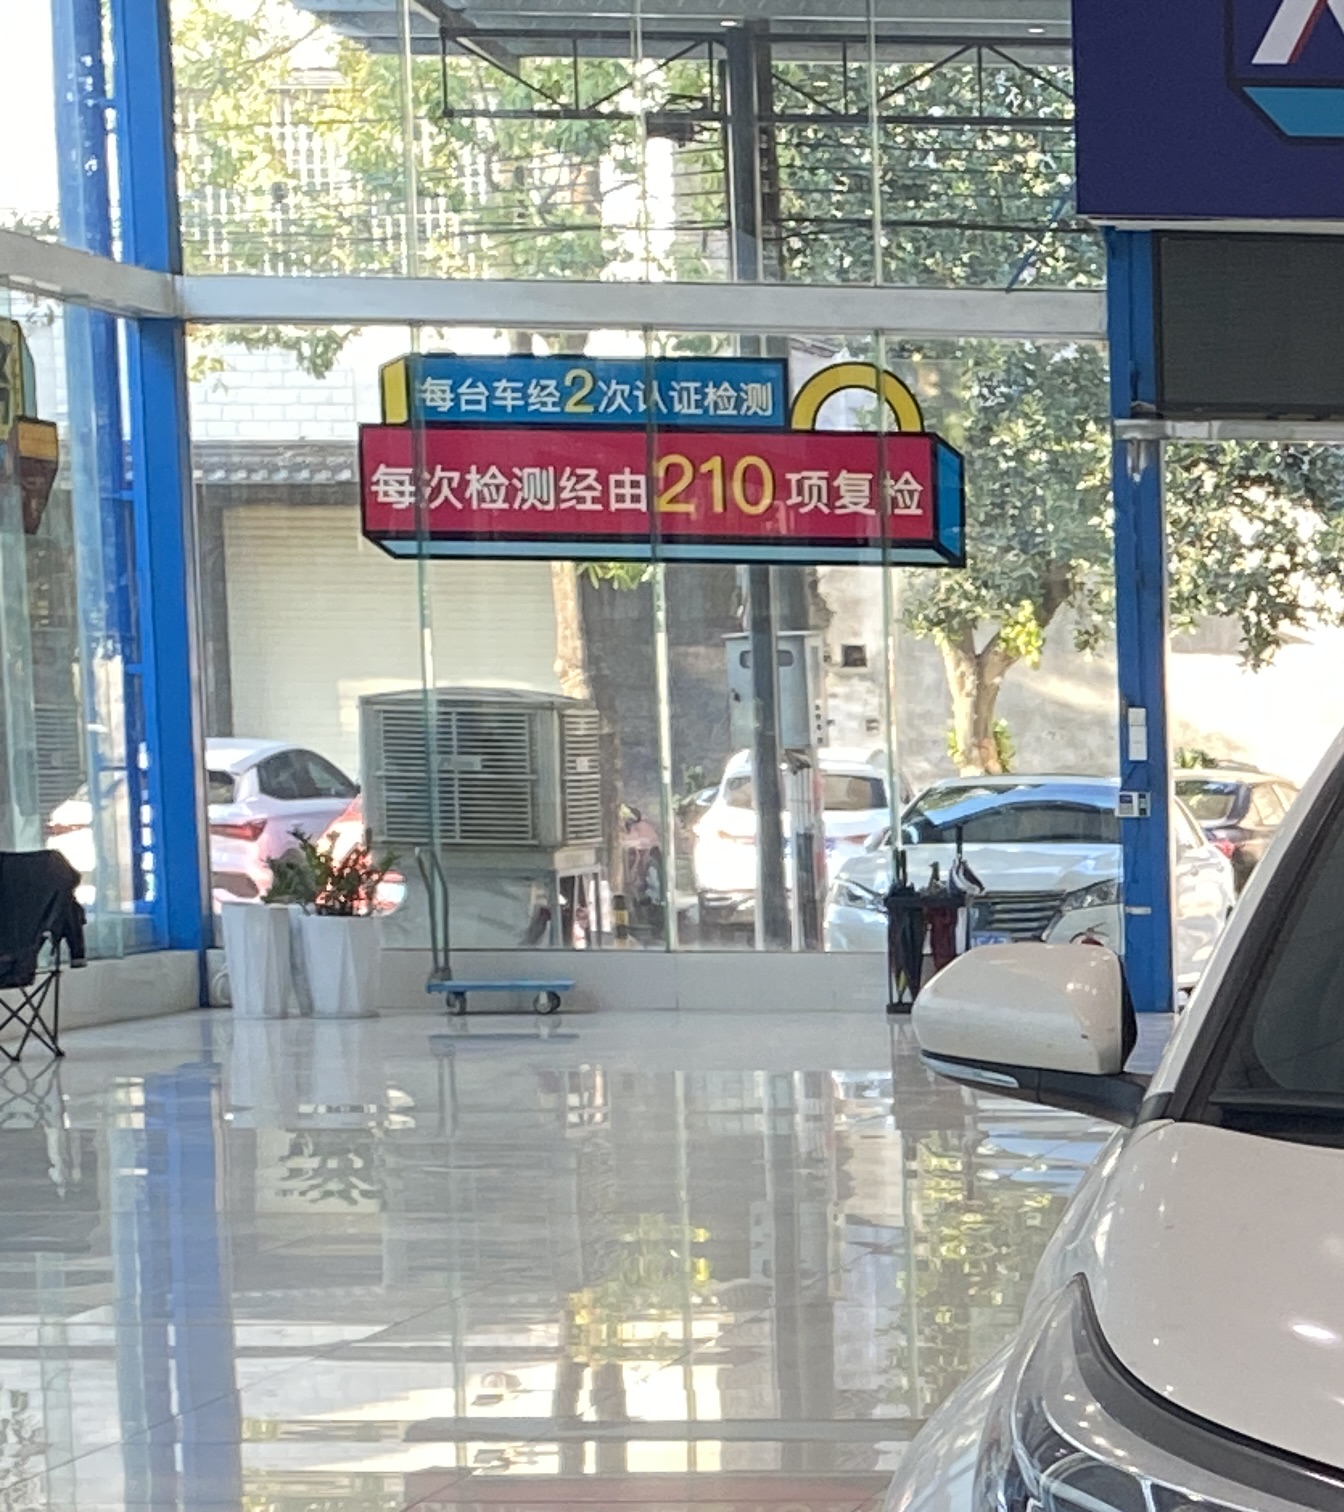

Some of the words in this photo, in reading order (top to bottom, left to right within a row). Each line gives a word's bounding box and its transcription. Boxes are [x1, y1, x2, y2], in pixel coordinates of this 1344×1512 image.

[417, 367, 775, 420] 每台车经2次认证检测
[371, 454, 925, 519] 每次检测经由210项复检
